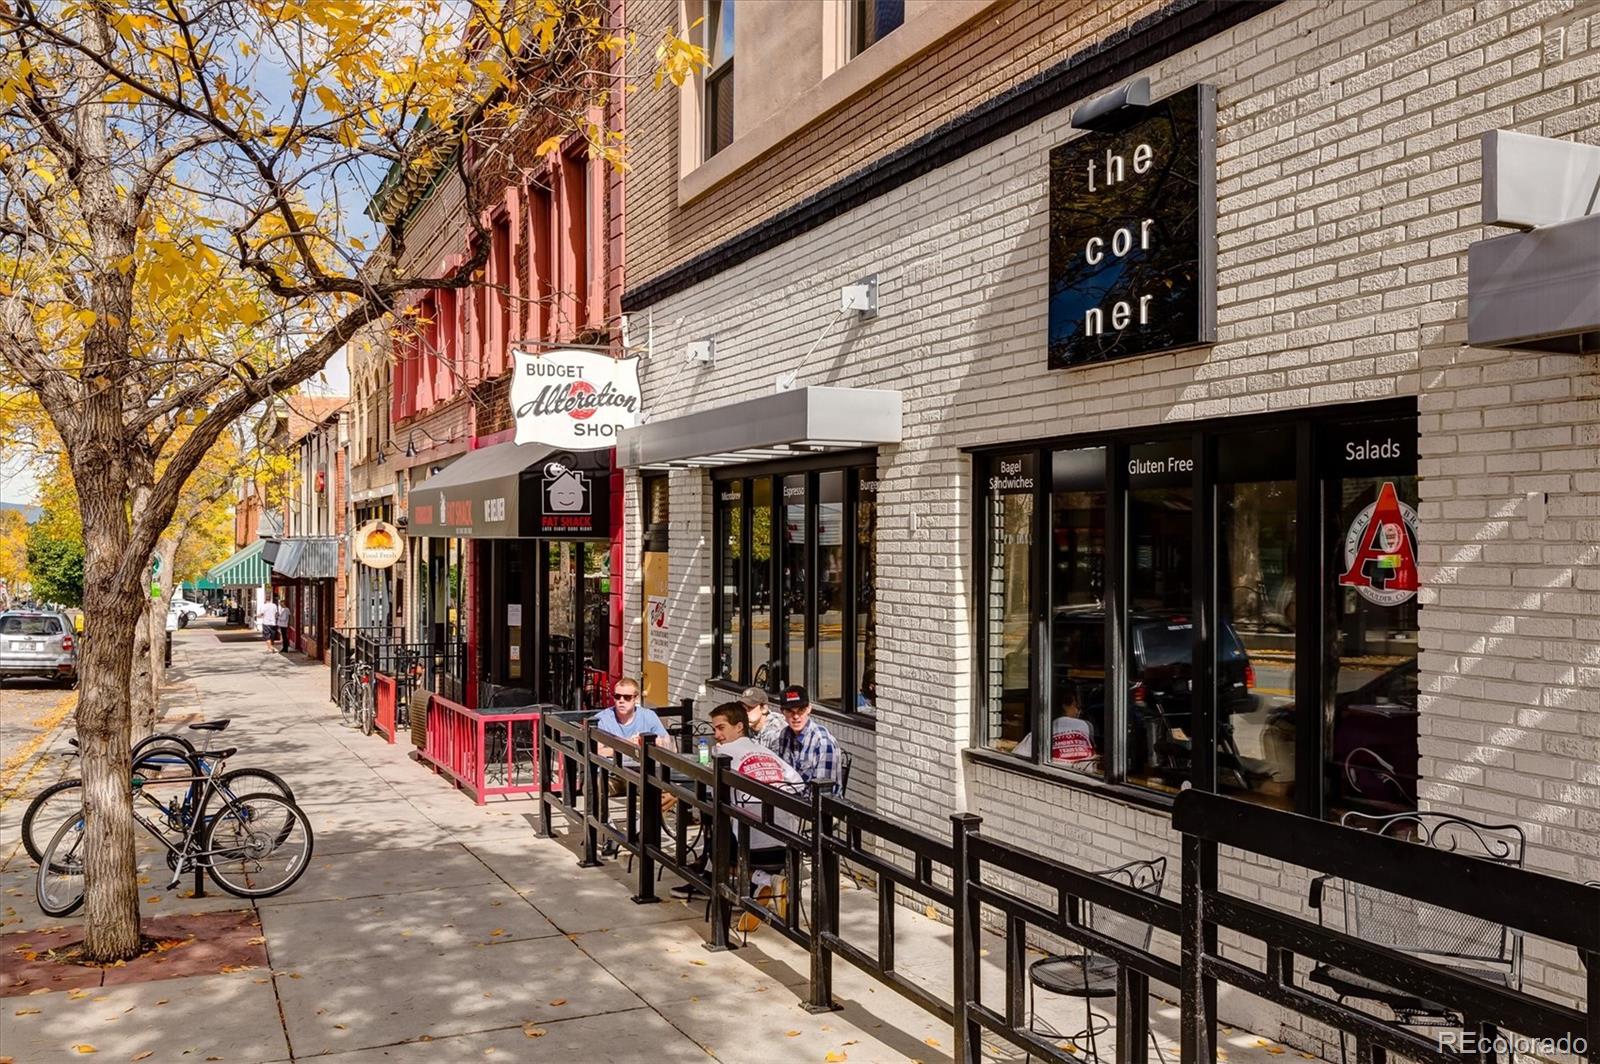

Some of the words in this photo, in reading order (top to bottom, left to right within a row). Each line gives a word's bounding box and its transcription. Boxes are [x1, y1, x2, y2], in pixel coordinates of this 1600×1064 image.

[1087, 144, 1153, 192] the
[1085, 218, 1154, 266] cor
[1085, 294, 1153, 337] ner
[526, 363, 584, 378] BUDGET
[516, 381, 638, 418] Alteration
[574, 423, 625, 437] SHOP
[1345, 438, 1400, 461] Salads
[1000, 460, 1022, 474] Bagel
[1128, 459, 1165, 475] Gluten
[1168, 457, 1194, 472] Free
[783, 486, 805, 498] Espresso
[989, 476, 1034, 490] Sandwiches
[541, 516, 558, 527] FAT
[561, 516, 592, 527] SHACK
[1348, 511, 1370, 555] AVERY
[1404, 510, 1418, 531] BR
